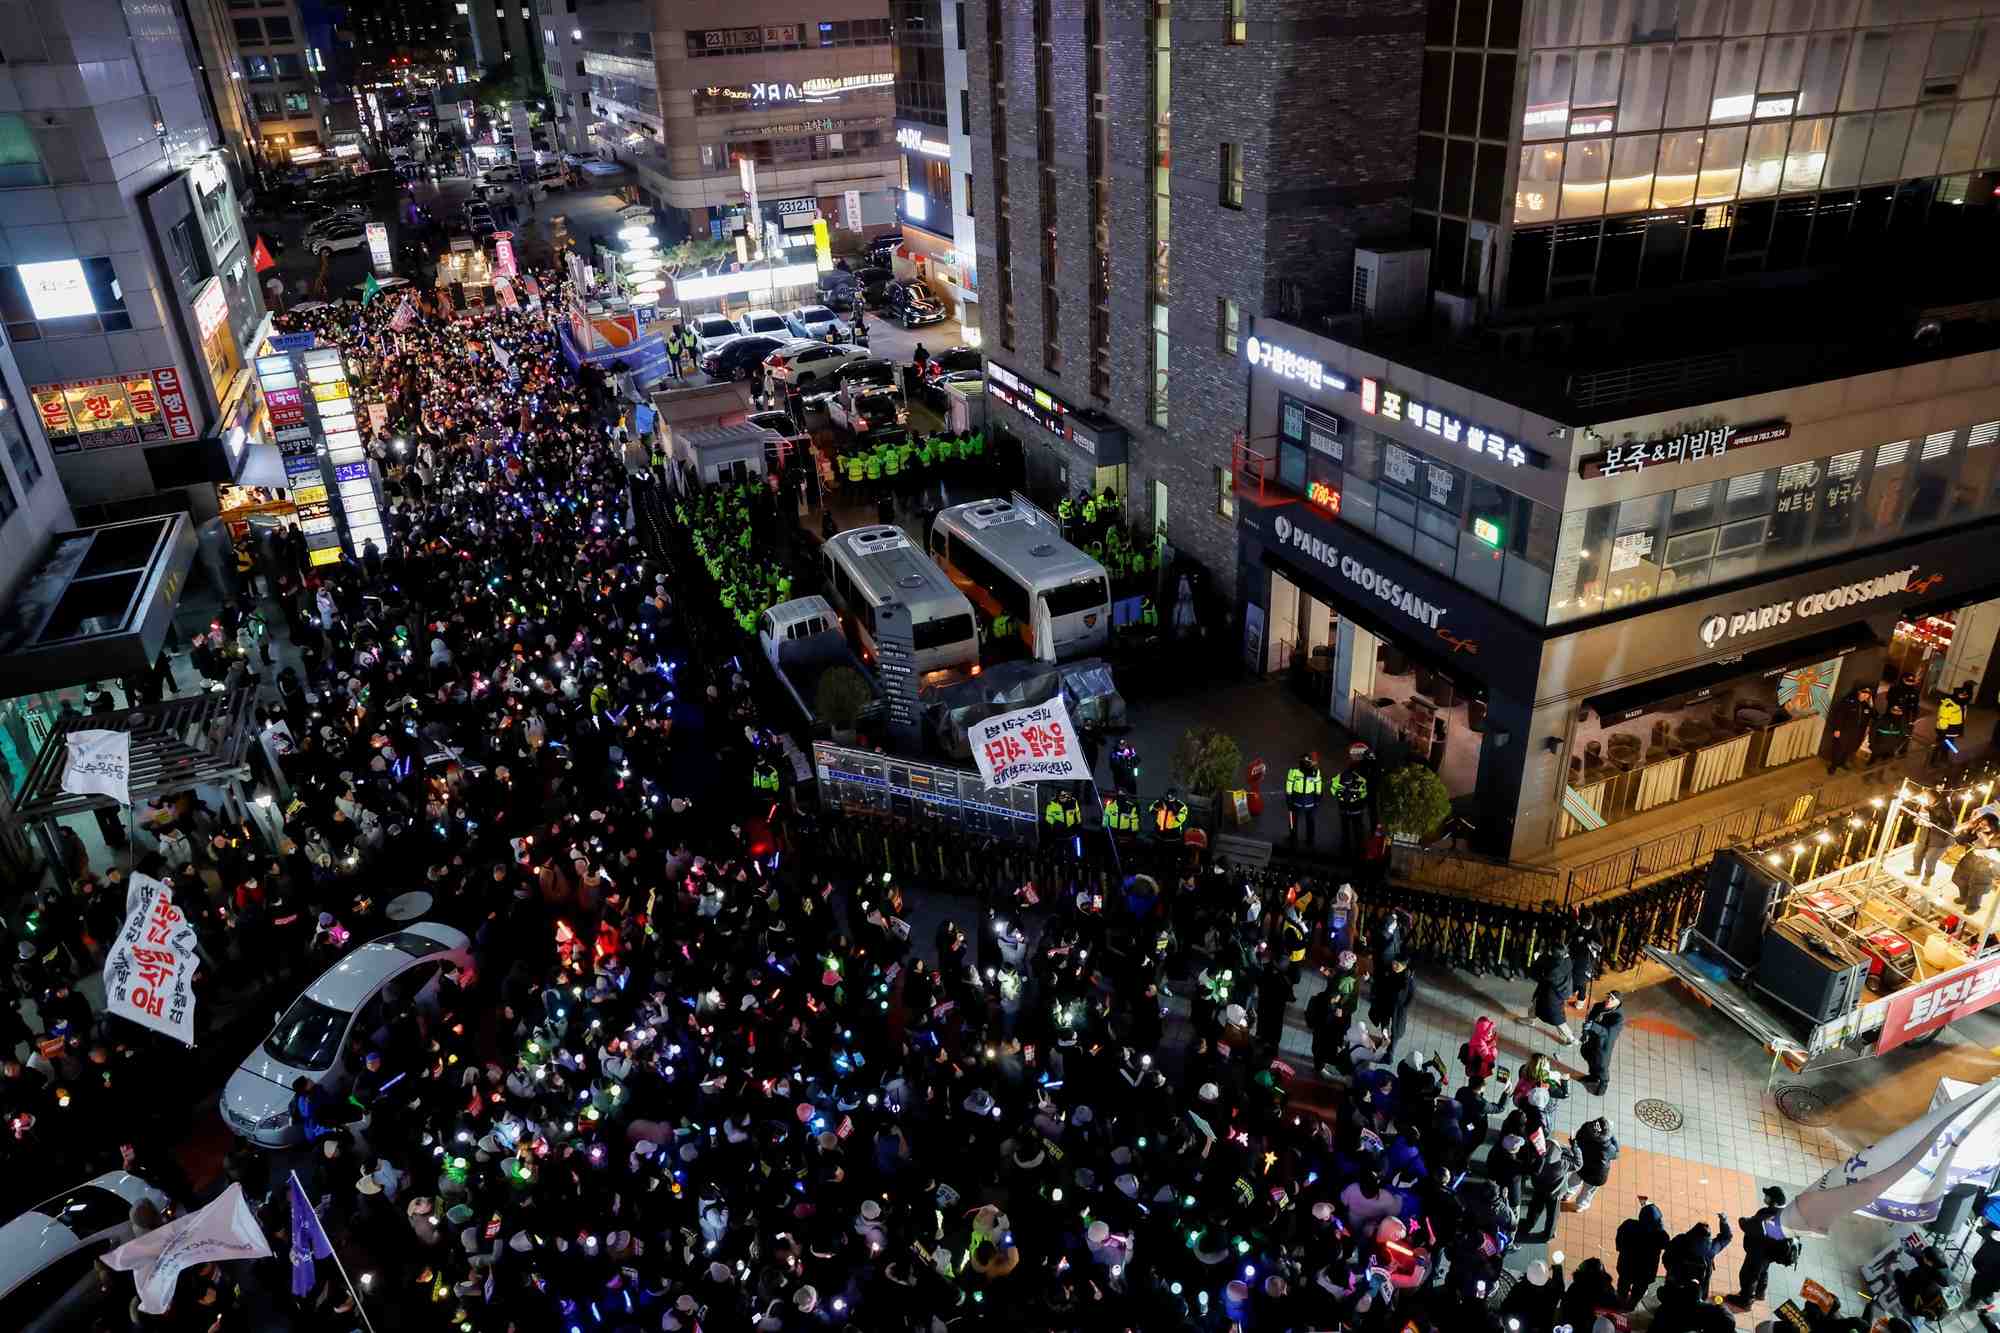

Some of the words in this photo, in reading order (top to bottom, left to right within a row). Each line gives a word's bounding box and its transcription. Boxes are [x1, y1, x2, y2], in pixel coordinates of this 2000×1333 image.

[1407, 401, 1461, 442] 베트남
[1467, 425, 1525, 467] 쌀국수
[1600, 426, 1736, 477] 본죽&비빔밥
[1778, 491, 1816, 512] 베트남
[1293, 526, 1339, 568] PARIS
[1340, 555, 1442, 629] CROISSANT
[1728, 600, 1793, 638] PARIS
[1797, 569, 1915, 618] CROISSANT
